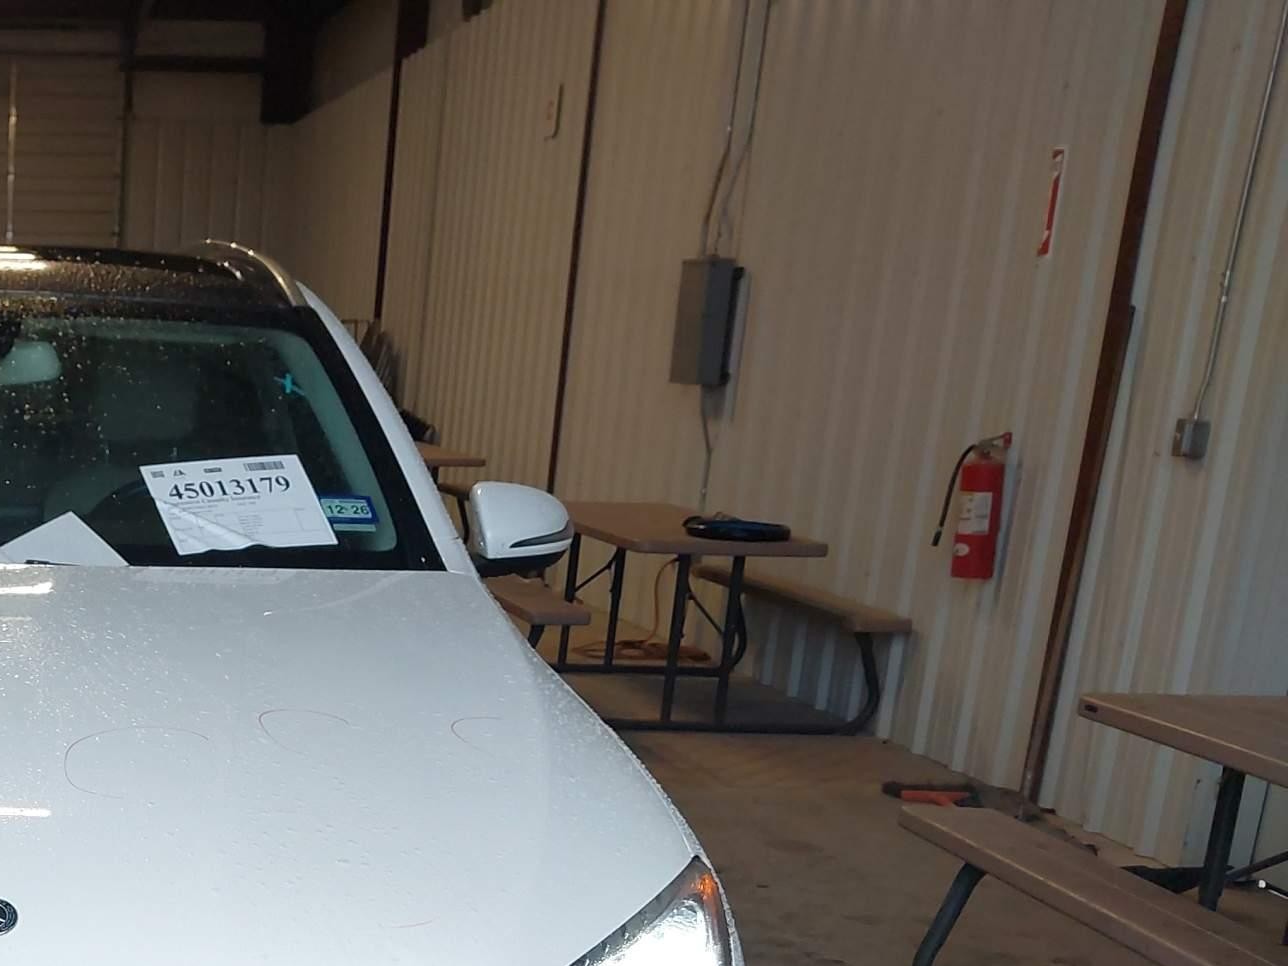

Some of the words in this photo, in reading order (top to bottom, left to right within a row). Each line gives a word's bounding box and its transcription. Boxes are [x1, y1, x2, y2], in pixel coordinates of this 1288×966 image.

[169, 475, 291, 500] 45013179
[327, 504, 345, 515] 12
[351, 504, 370, 515] 26
